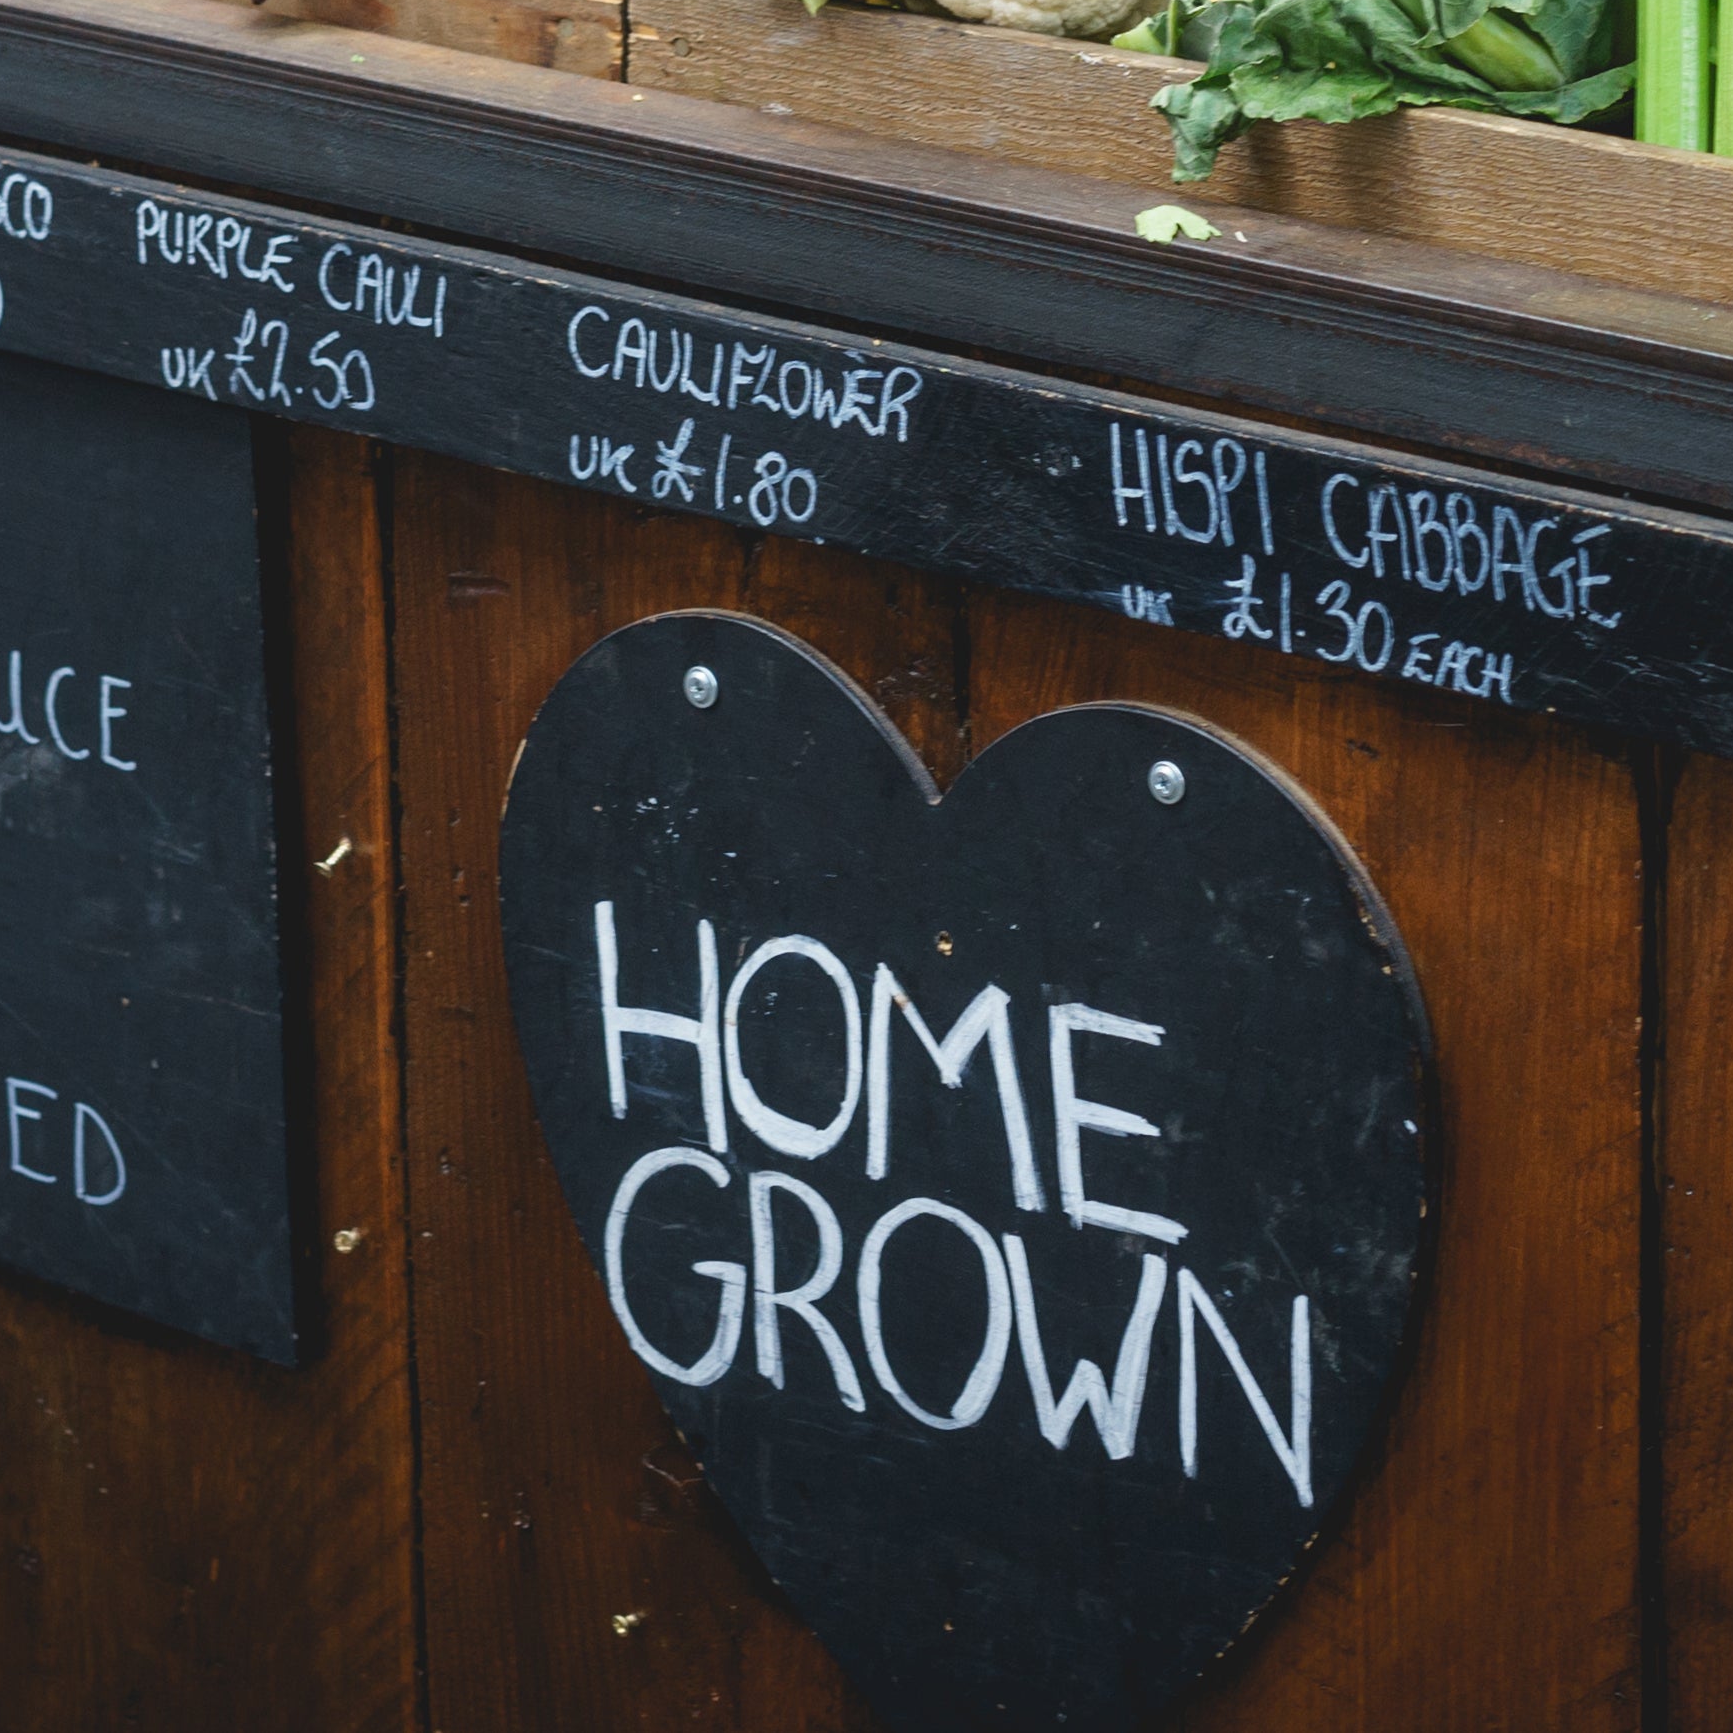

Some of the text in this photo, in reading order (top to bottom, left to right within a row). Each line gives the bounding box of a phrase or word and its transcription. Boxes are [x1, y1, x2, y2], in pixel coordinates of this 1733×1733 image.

[136, 199, 447, 338] PURPLE CAULI
[161, 307, 375, 410] UK £2.50
[567, 305, 923, 442] CAULIFLOWER
[569, 417, 818, 526] UK £1.80
[1109, 422, 1622, 629] HISPI CABBAGE
[1120, 554, 1514, 705] UK £1.30 EACH
[594, 901, 1188, 1244] HOME
[604, 1146, 1314, 1508] GROWN
